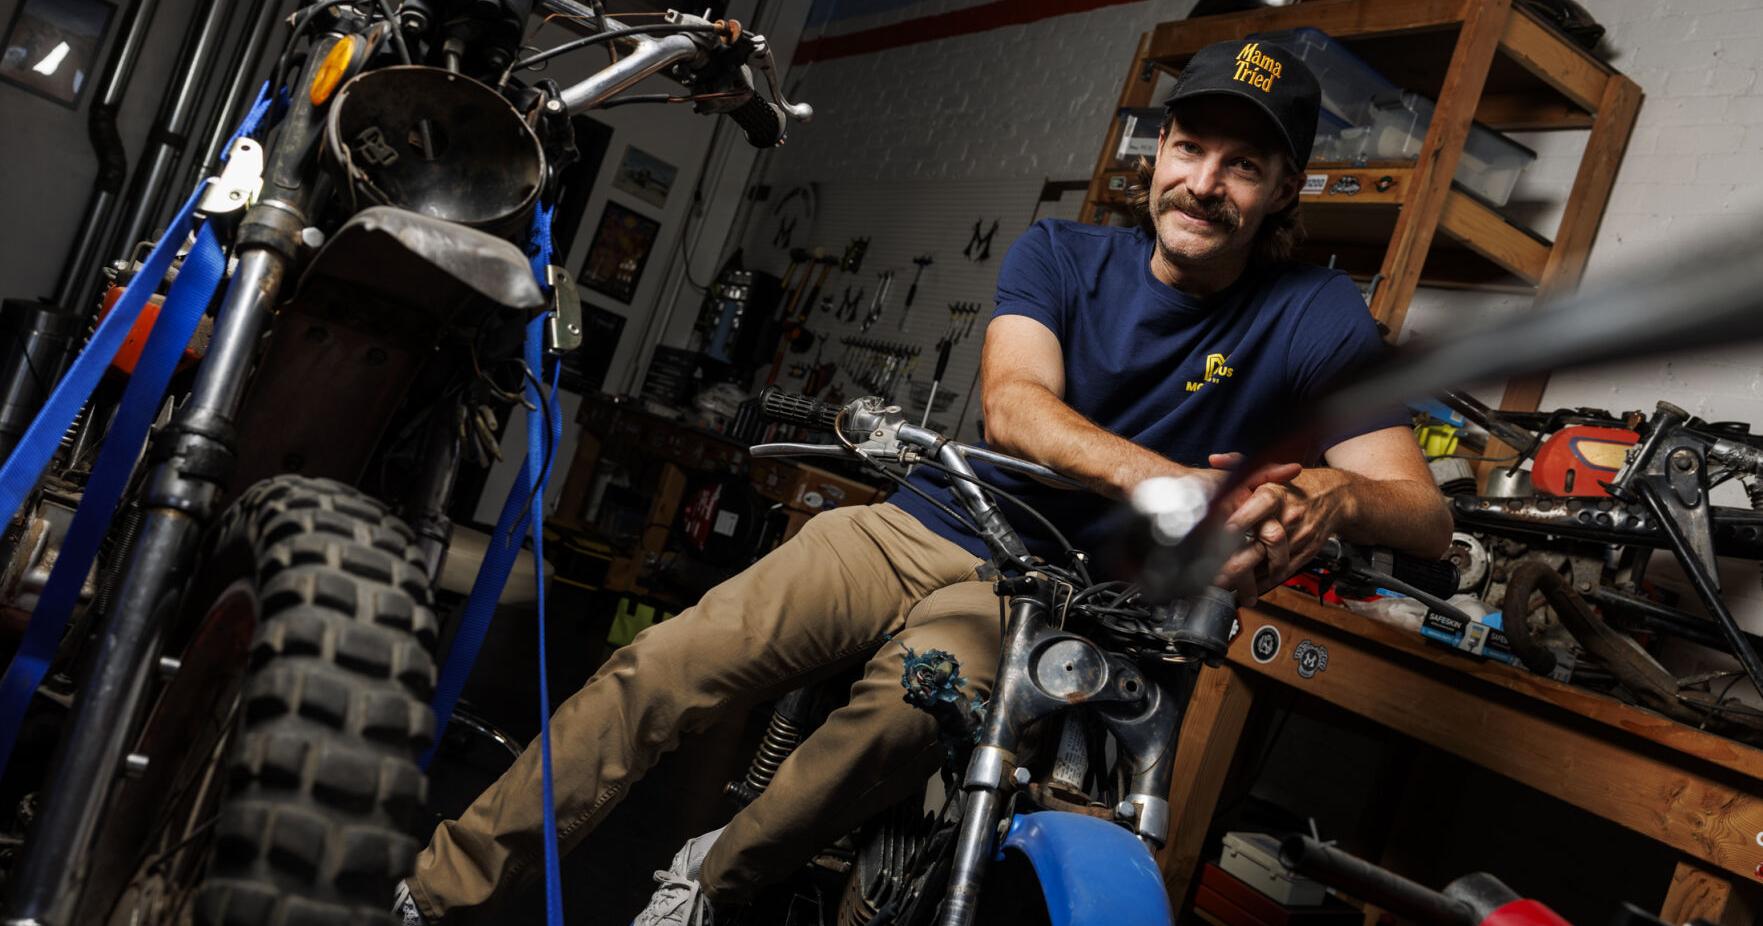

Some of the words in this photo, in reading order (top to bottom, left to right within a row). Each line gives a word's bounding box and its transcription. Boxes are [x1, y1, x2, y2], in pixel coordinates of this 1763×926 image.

[1232, 60, 1274, 93] Tried
[1235, 42, 1283, 79] Mama
[1429, 612, 1463, 630] SAFESKIN
